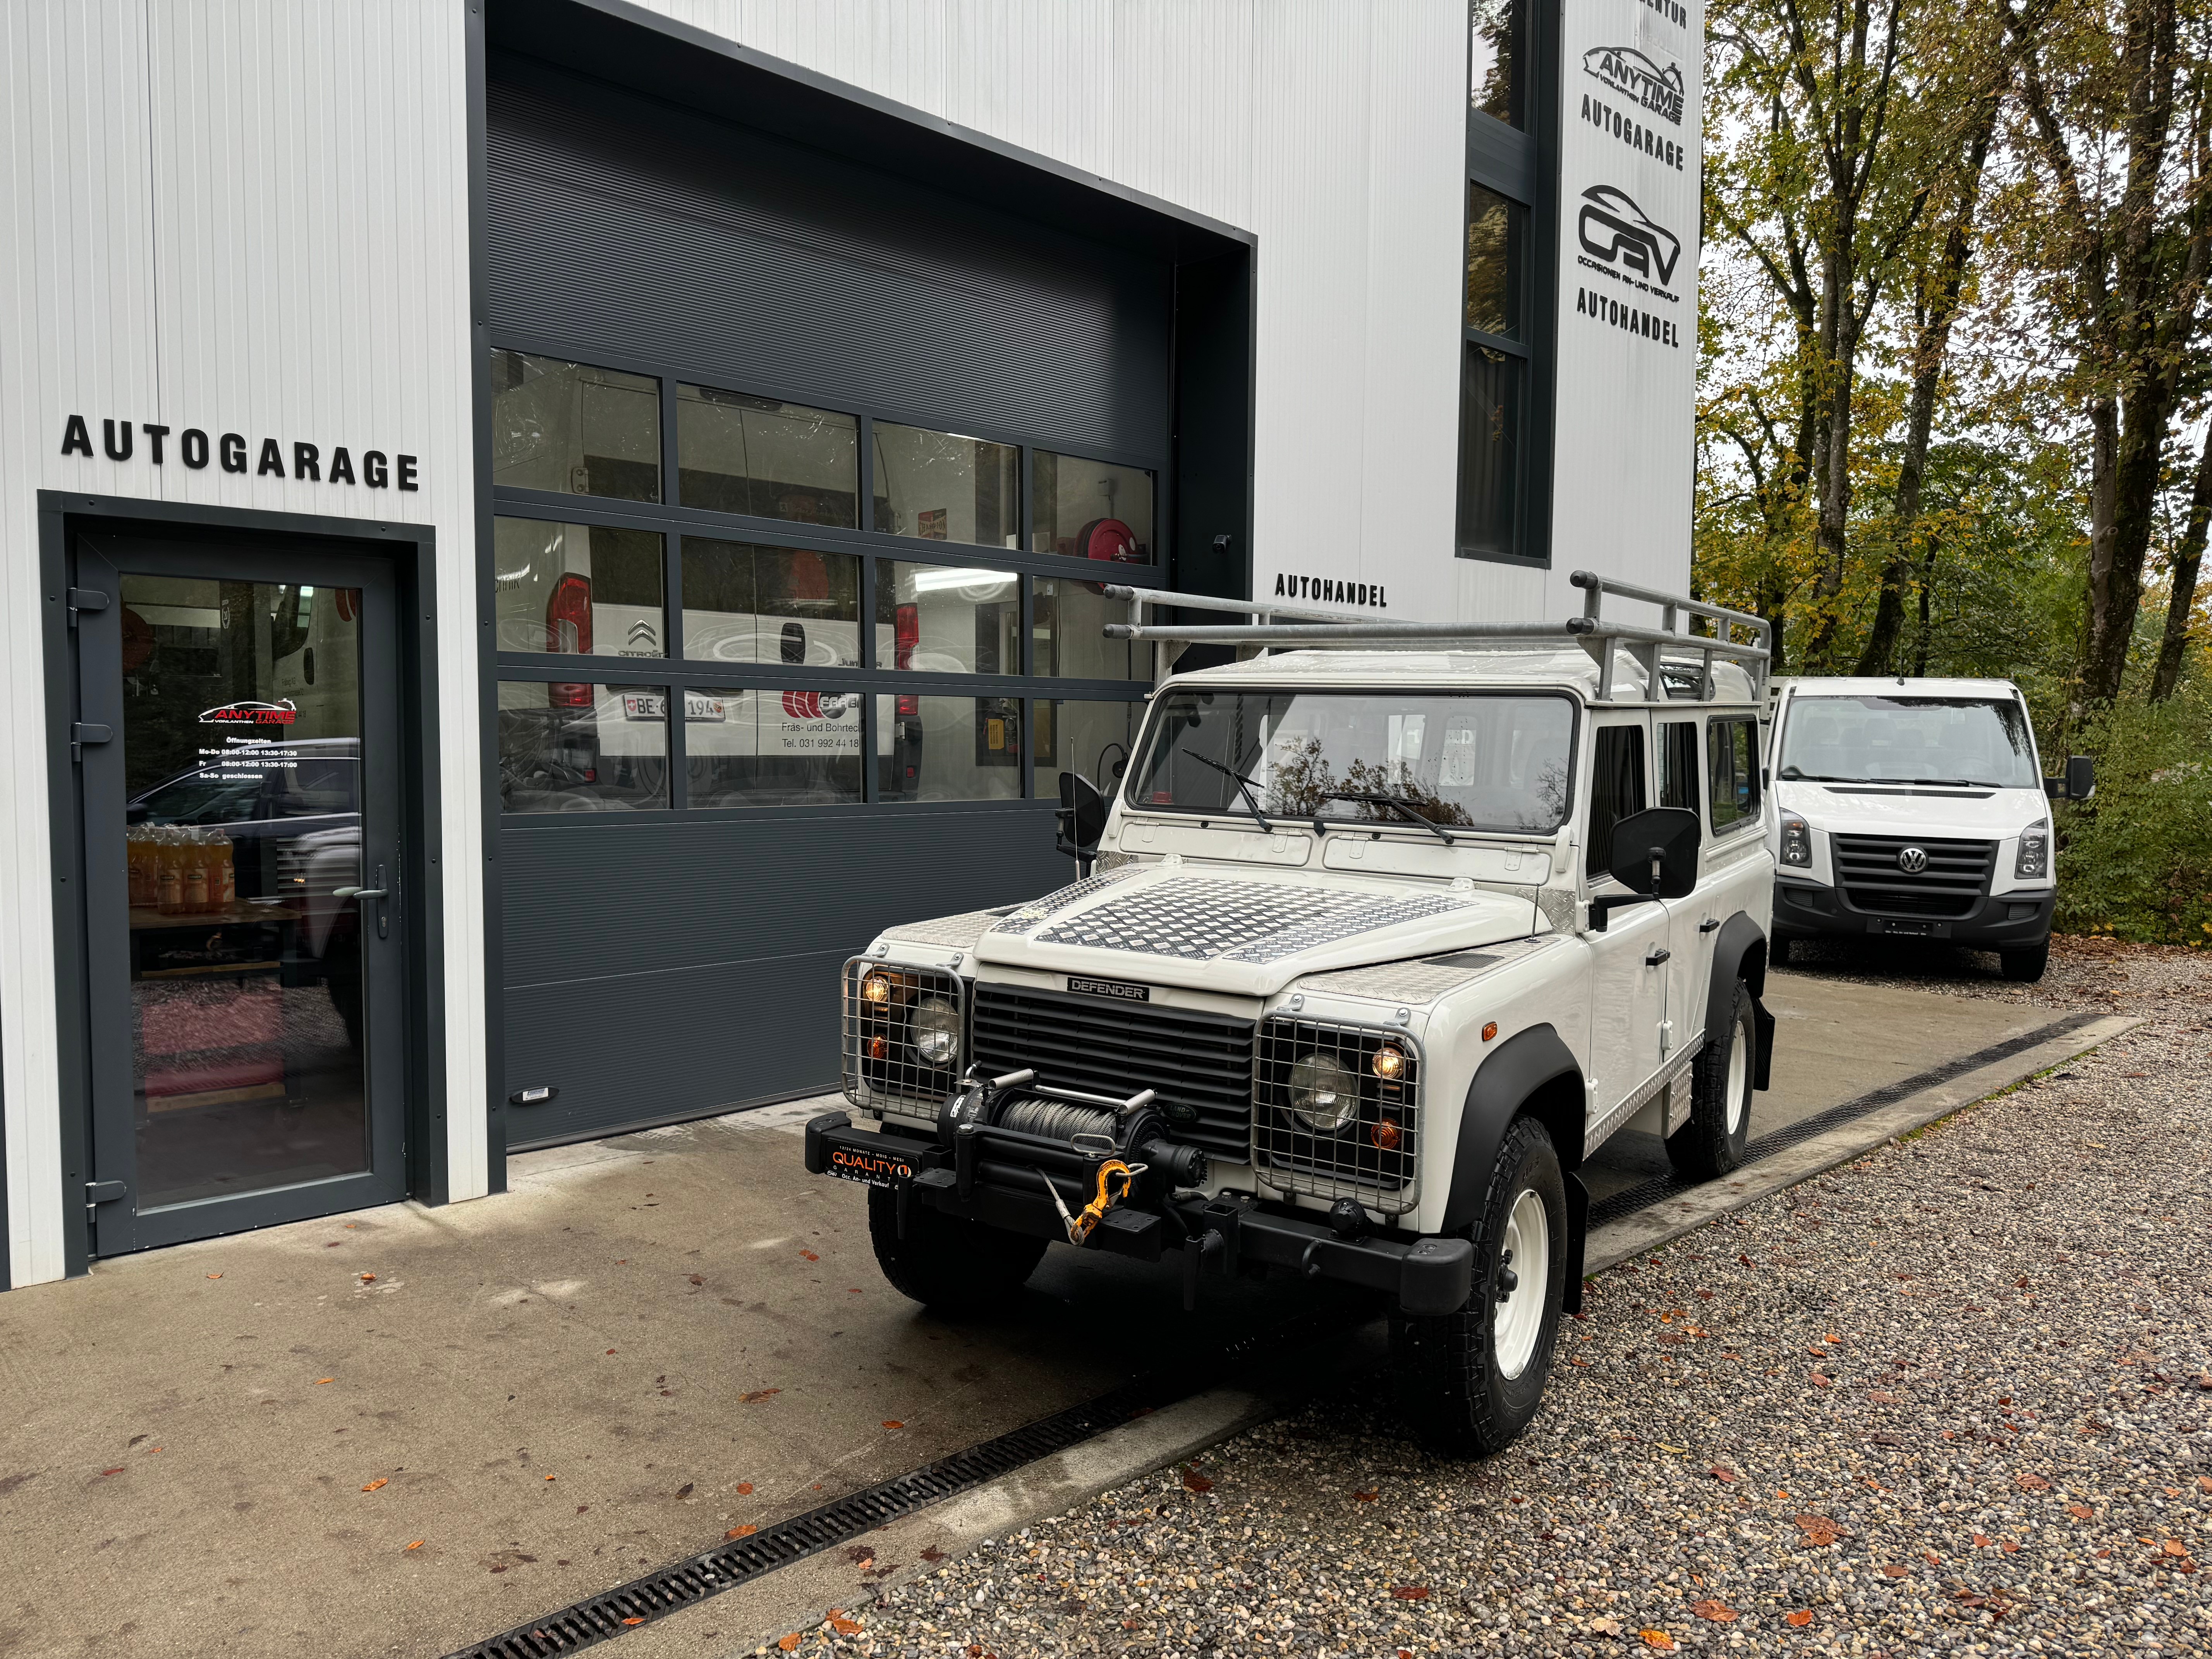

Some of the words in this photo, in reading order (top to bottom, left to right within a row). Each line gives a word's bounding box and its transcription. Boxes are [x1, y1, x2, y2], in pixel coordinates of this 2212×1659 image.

[1600, 53, 1684, 115] ANYTIME
[1600, 74, 1639, 103] VONLANTHEN
[1641, 96, 1682, 125] GARAGE
[1582, 94, 1683, 171] AUTOGARAGE
[1578, 255, 1620, 281] OCCASIONEN
[1635, 280, 1649, 292] UND
[1650, 286, 1680, 303] VERKAUF
[1577, 287, 1679, 348] AUTOHANDEL
[61, 414, 419, 491] AUTOGARAGE
[1275, 573, 1386, 607] AUTOHANDEL
[215, 710, 296, 720] ANYTIME
[782, 723, 804, 732] Fräs-
[807, 723, 823, 732] und
[826, 723, 859, 732] Bohrtec
[782, 739, 796, 747] Tel.
[799, 739, 814, 747] 031
[818, 739, 833, 747] 992
[849, 739, 859, 747] 18
[1072, 980, 1143, 998] DEFENDER
[833, 1152, 895, 1175] QUALITY
[872, 1180, 890, 1188] Verkauf
